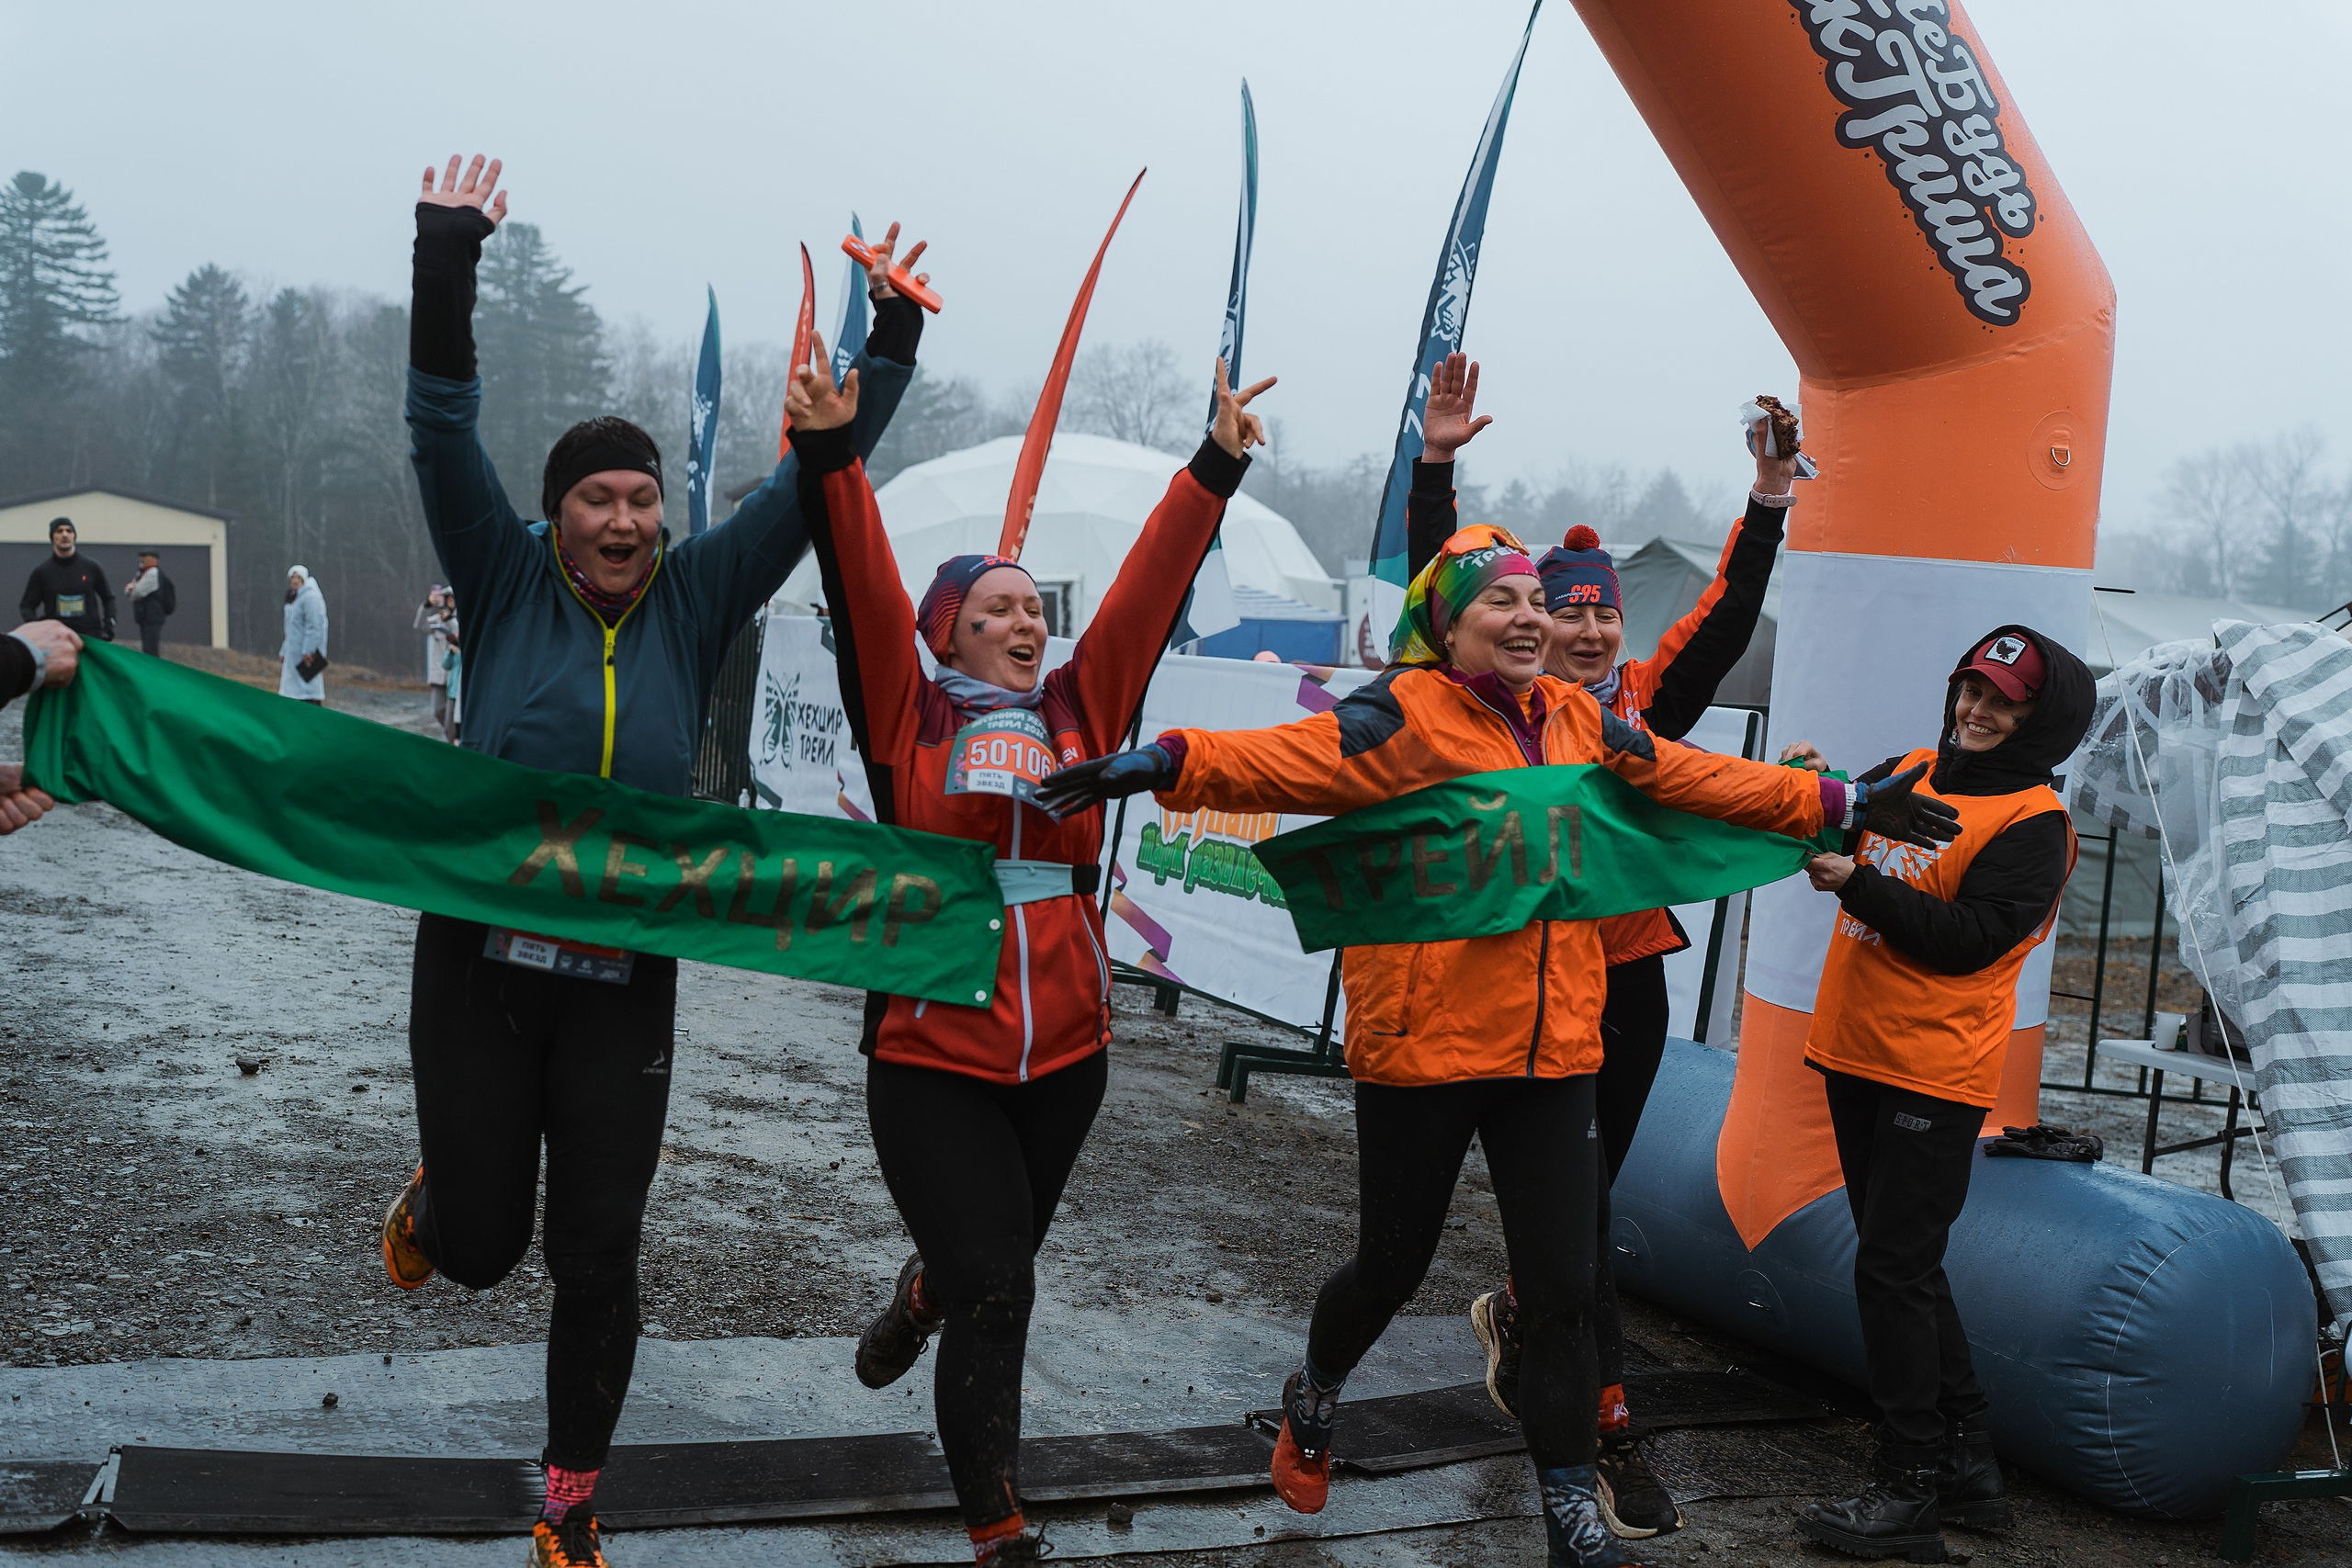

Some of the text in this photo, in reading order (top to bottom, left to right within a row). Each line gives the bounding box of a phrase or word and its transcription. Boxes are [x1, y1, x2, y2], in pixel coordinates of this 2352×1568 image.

[1804, 0, 2023, 318] кТриша
[797, 702, 843, 735] ХЕХЦИР
[968, 738, 1052, 780] 50106
[506, 799, 943, 952] ХЕХЦИР
[1278, 791, 1582, 909] ТРЕЙЛ
